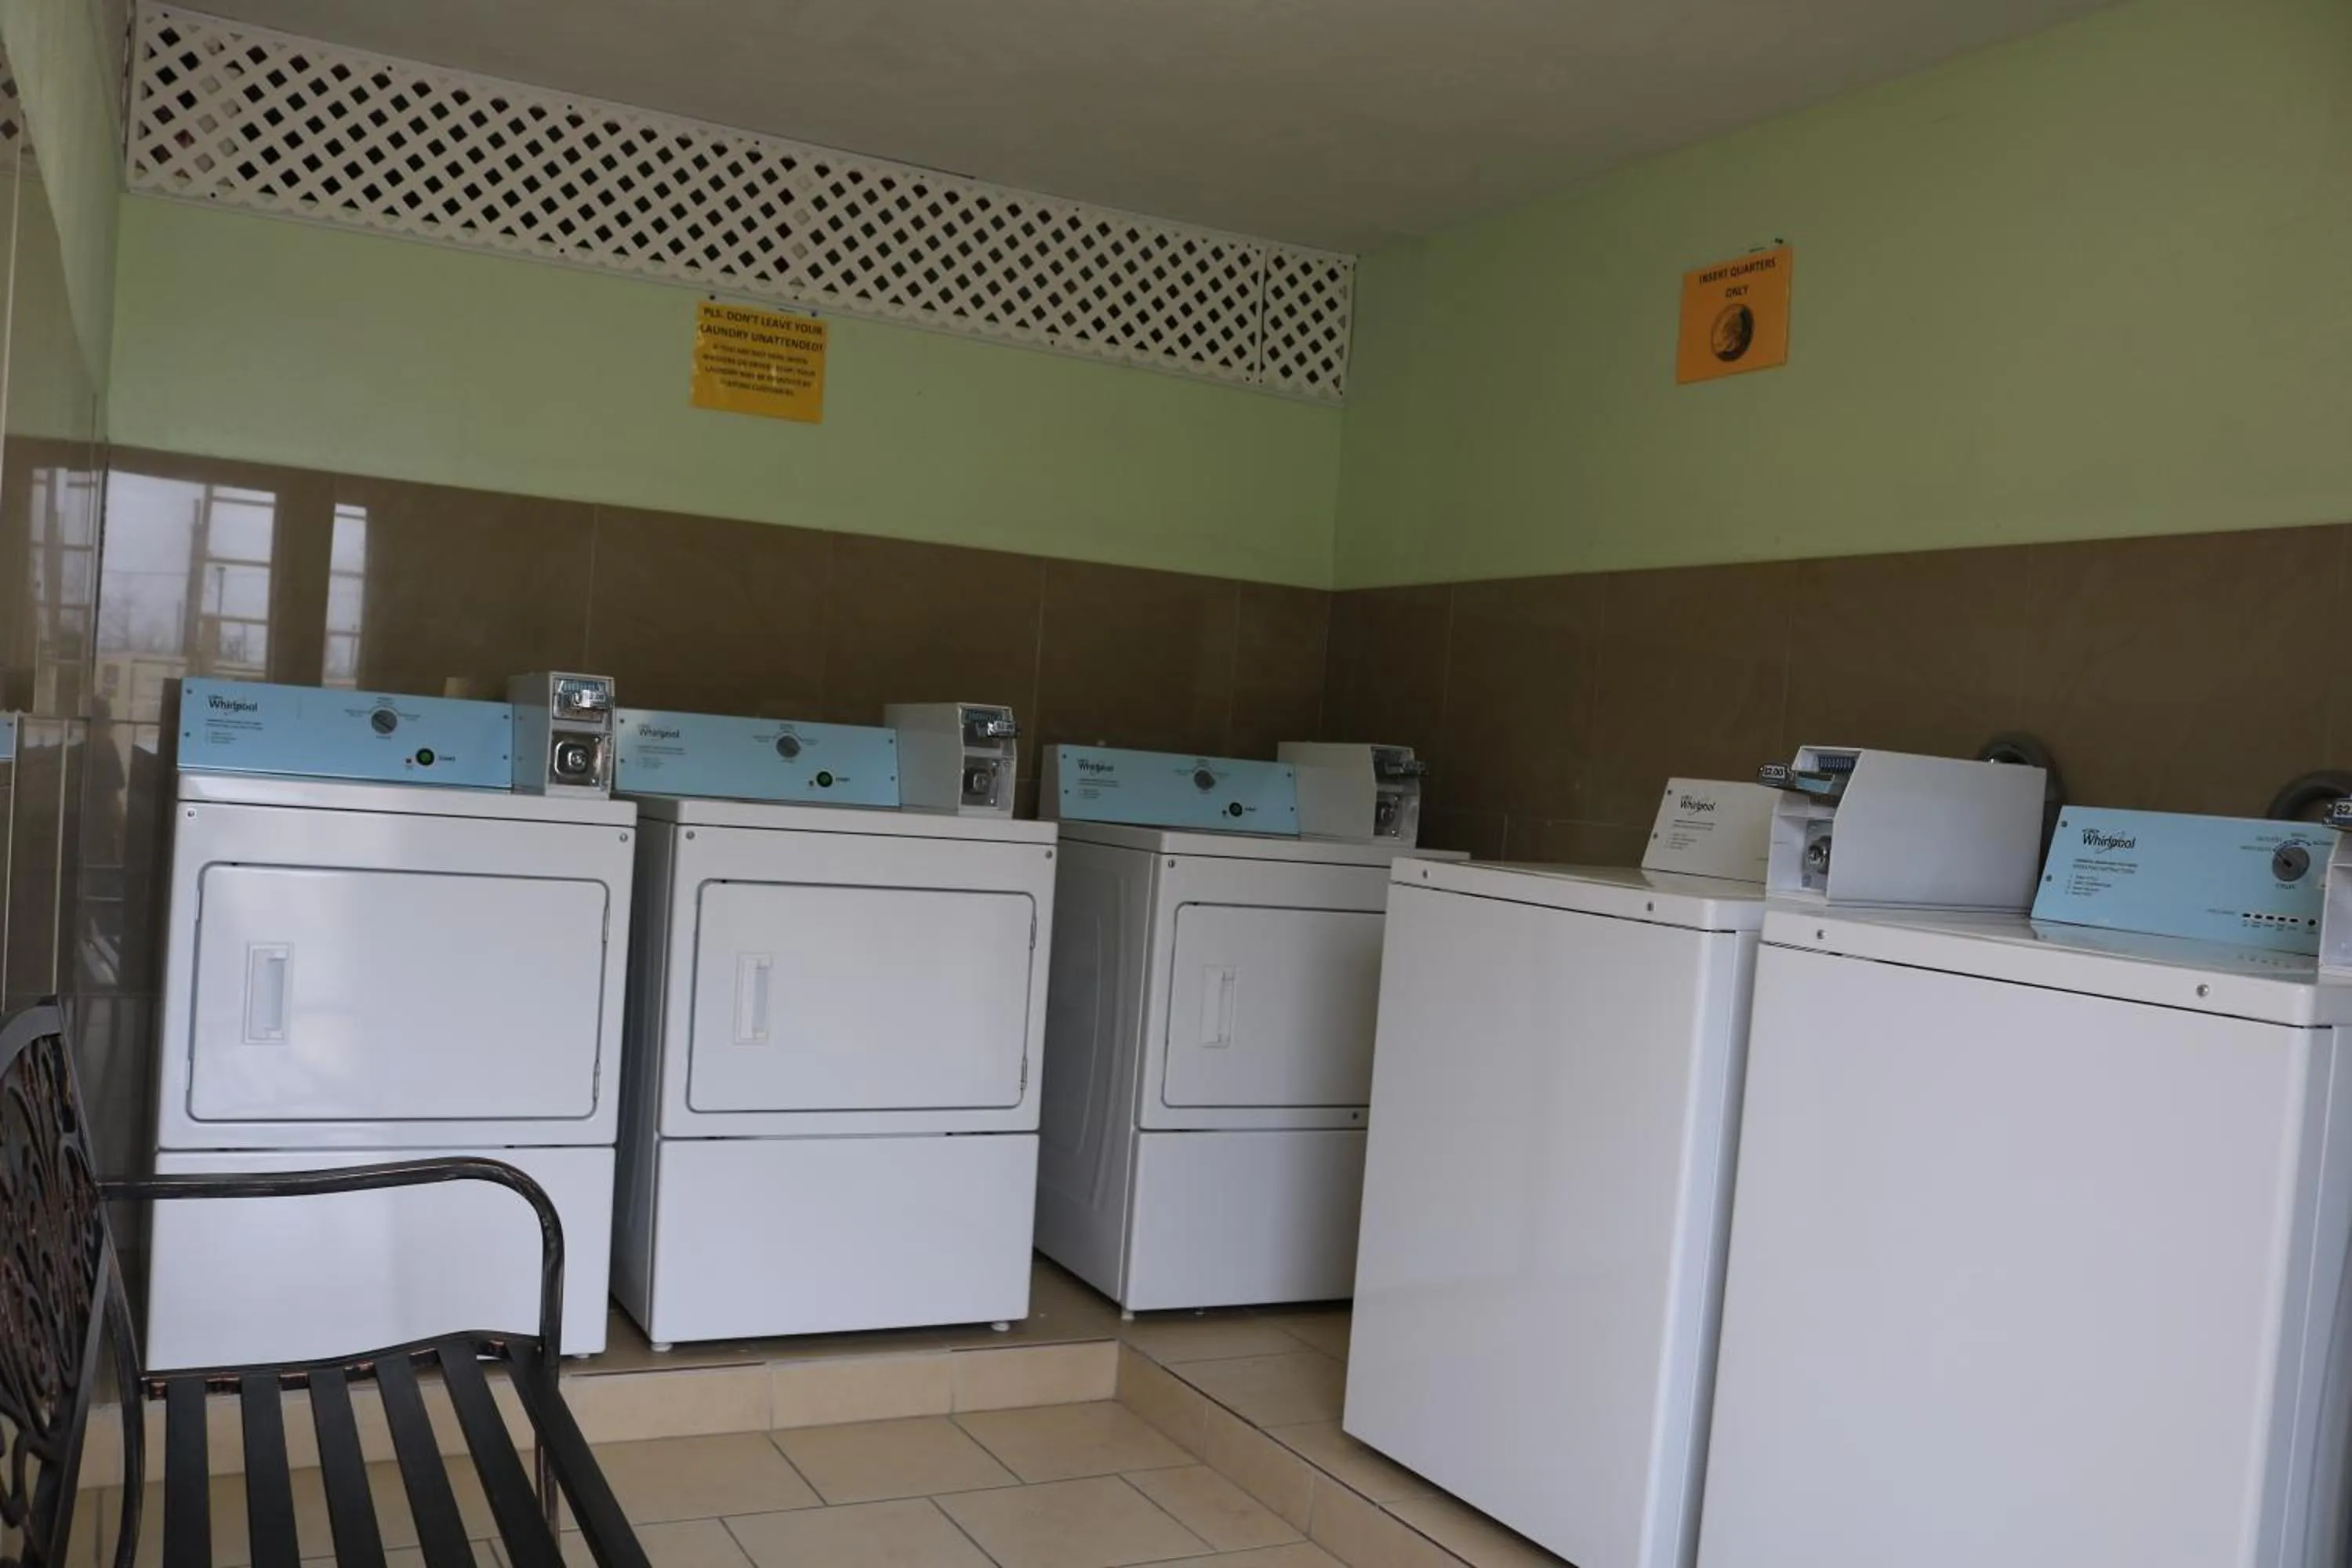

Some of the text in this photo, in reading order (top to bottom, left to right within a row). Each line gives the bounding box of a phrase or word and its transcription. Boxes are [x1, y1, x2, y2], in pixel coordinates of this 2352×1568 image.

[1699, 257, 1777, 284] INSERT QUARTERS
[1726, 285, 1749, 297] ONLY
[727, 311, 758, 325] DON'T
[761, 317, 791, 330] LEAVE
[795, 323, 822, 335] YOUR
[699, 324, 823, 352] LAUNDRY UNATTENDED!
[208, 698, 258, 712] Whirlpool
[638, 727, 680, 740] Whirlpool
[1680, 800, 1716, 812] Whirlpool
[2082, 833, 2137, 849] Whirlpool
